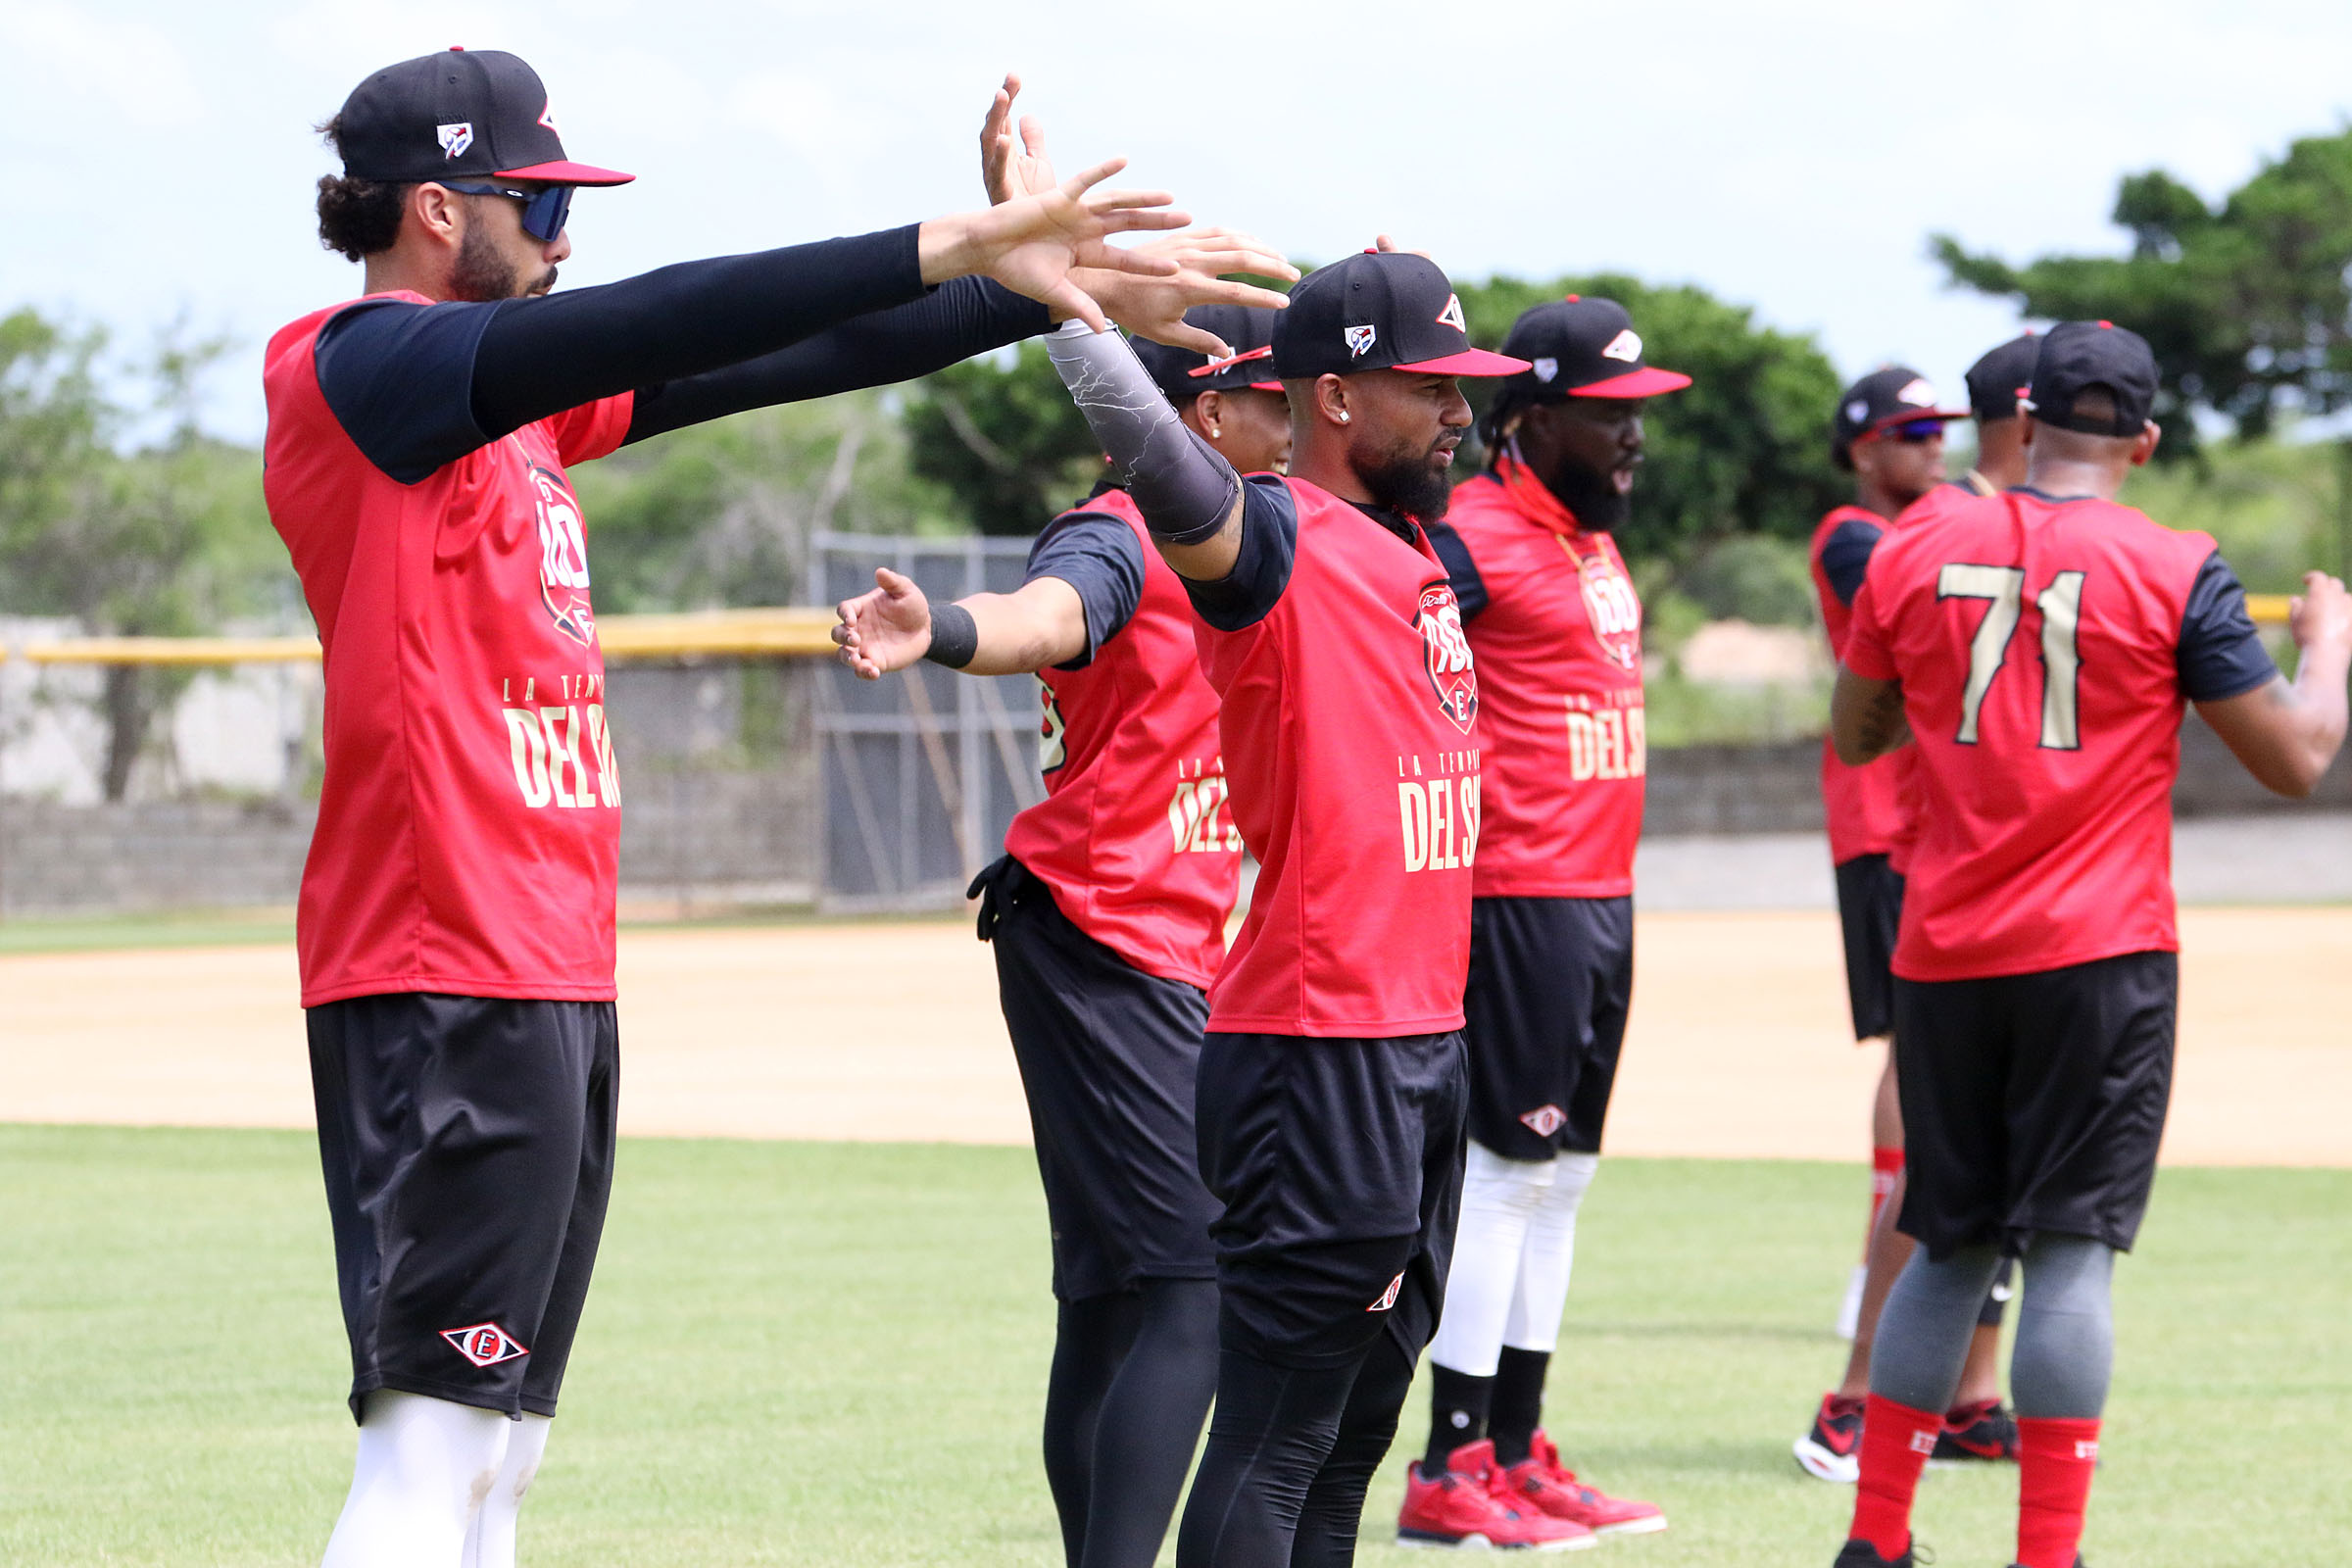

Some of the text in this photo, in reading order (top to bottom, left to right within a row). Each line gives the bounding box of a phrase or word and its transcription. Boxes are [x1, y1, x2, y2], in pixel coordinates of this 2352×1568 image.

[1936, 563, 2086, 751] 71
[503, 677, 535, 702] LA
[1454, 689, 1468, 722] E
[1398, 755, 1422, 777] LA
[475, 1332, 496, 1358] E
